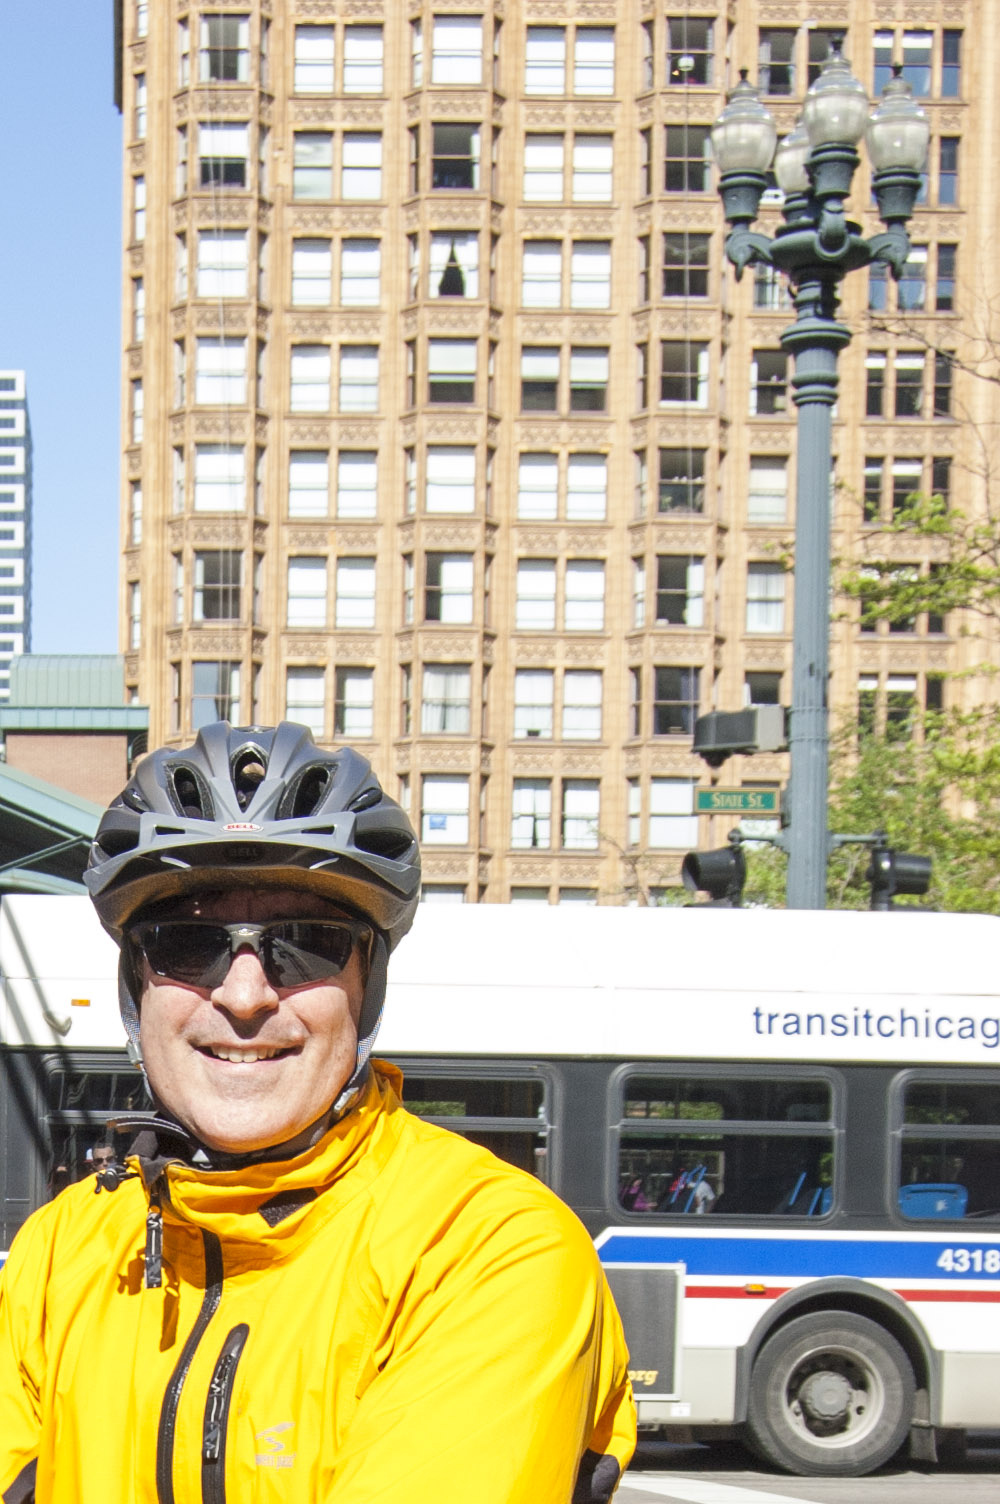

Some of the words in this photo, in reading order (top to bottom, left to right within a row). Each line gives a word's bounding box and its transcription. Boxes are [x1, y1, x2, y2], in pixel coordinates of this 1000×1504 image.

[711, 792, 744, 807] STATE
[753, 1007, 1000, 1048] transitchicag
[936, 1248, 1000, 1273] 4318
